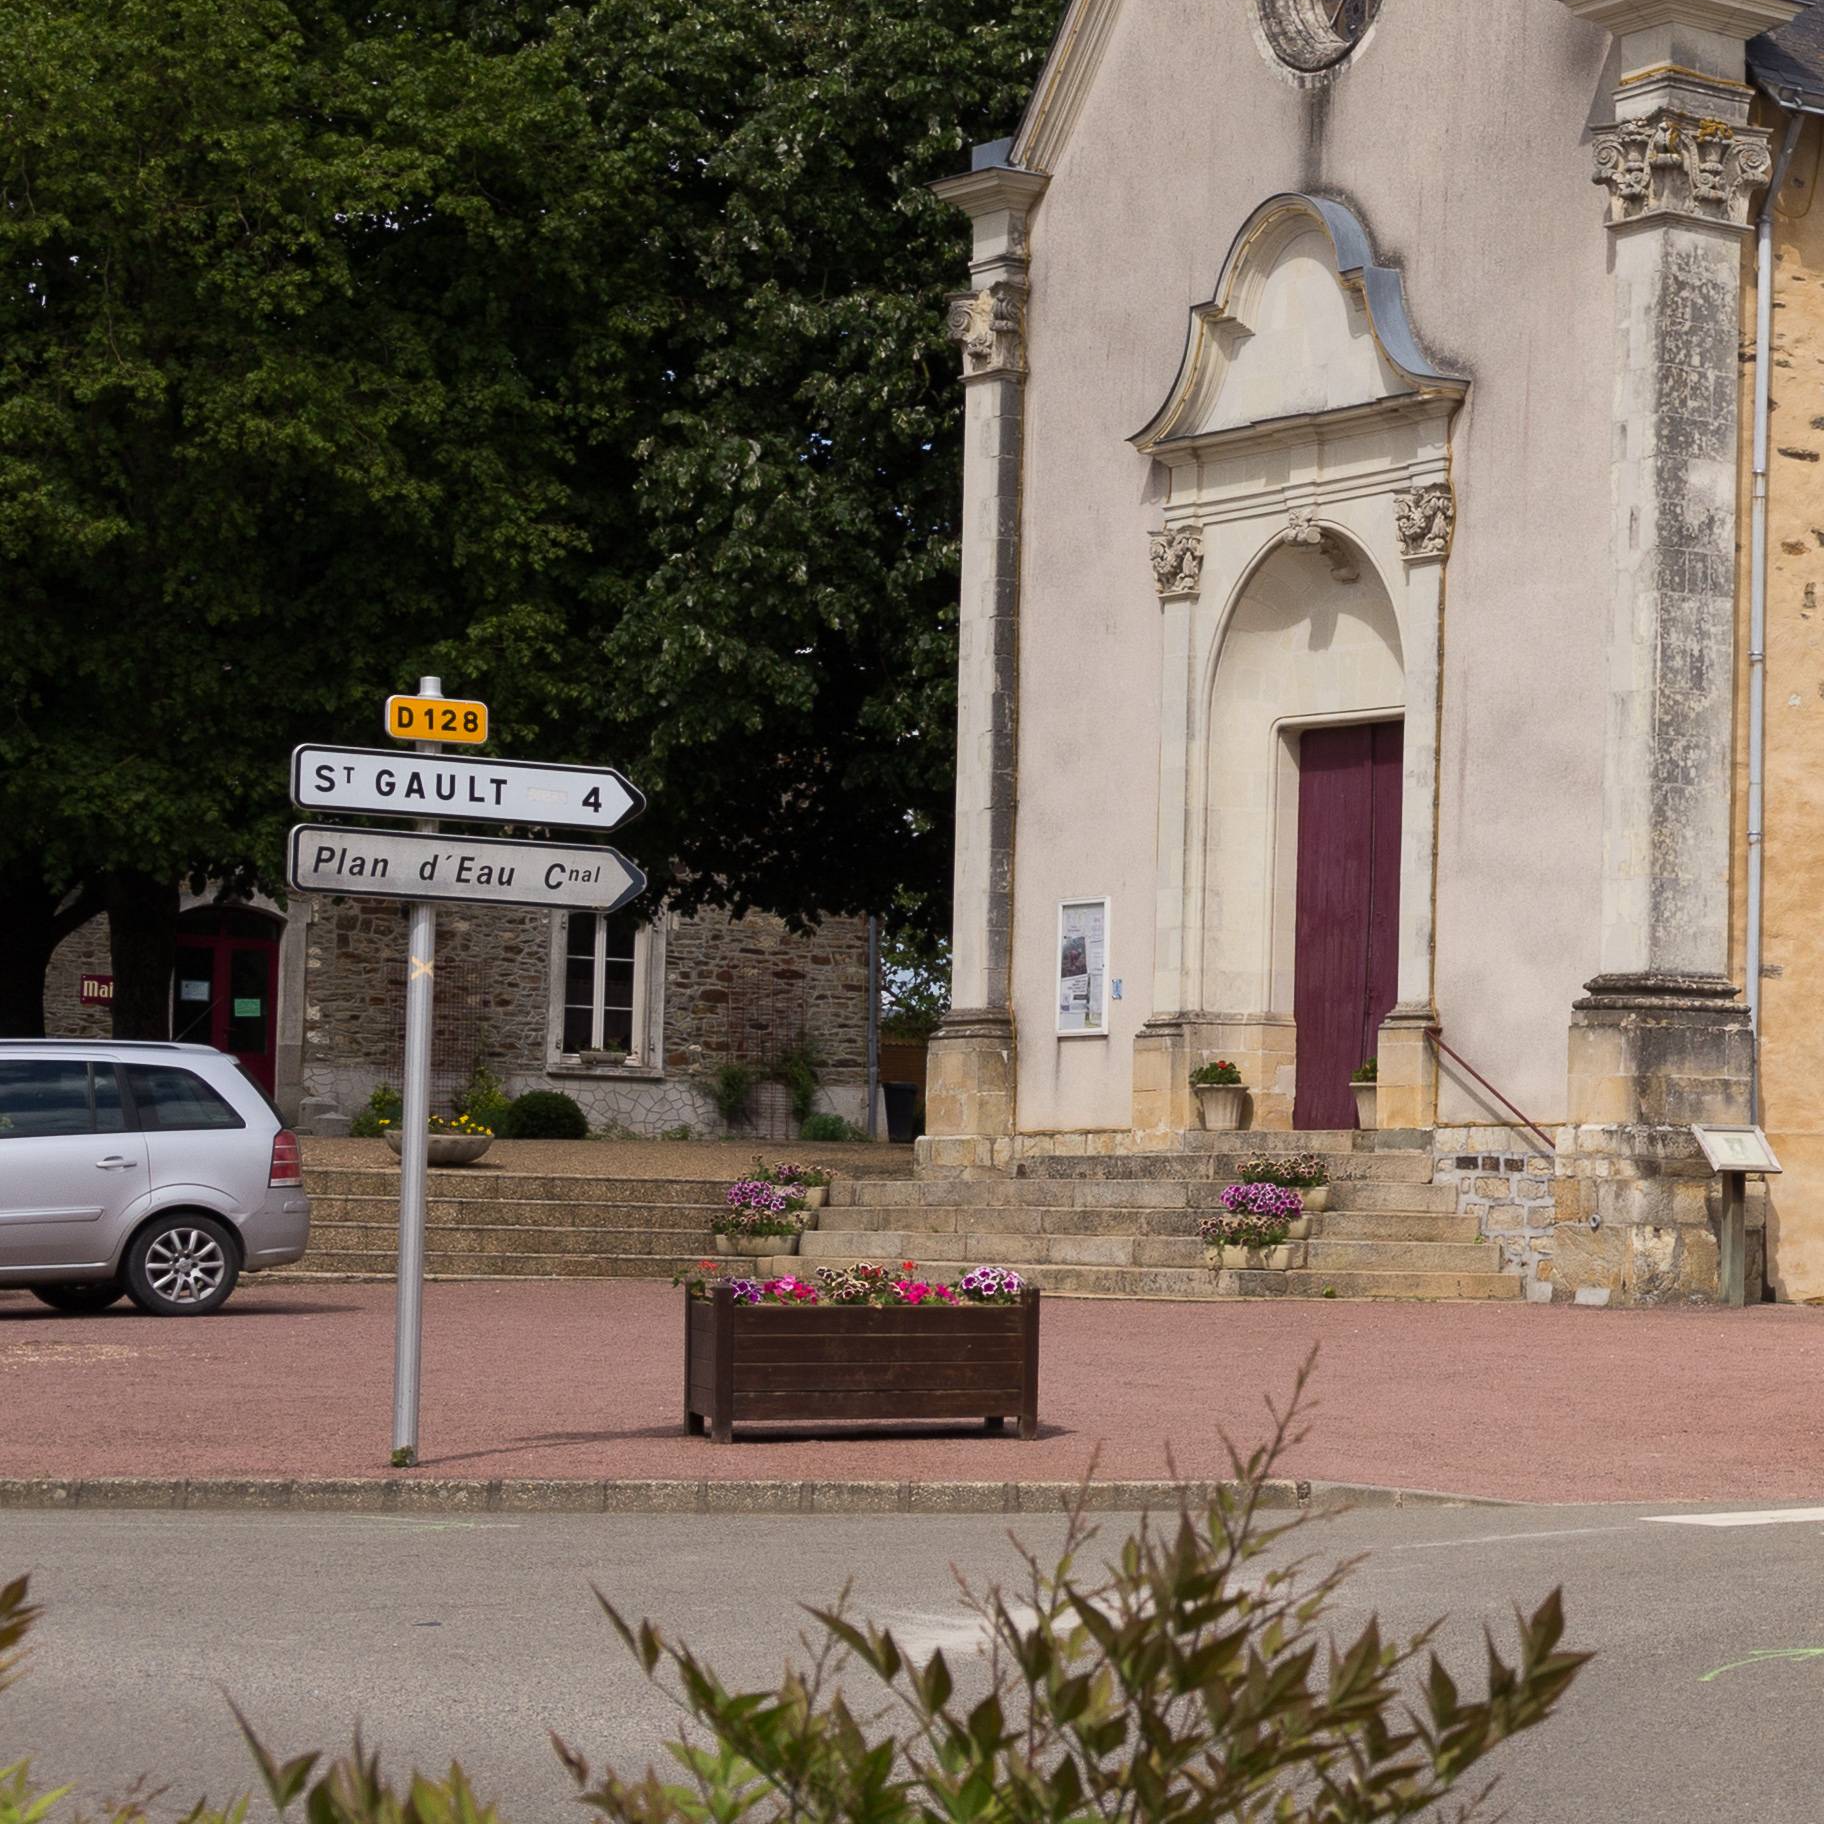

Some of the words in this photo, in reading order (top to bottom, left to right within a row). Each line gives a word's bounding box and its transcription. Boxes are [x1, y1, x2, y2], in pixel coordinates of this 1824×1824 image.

[397, 706, 413, 728] D
[424, 708, 479, 733] 128
[375, 769, 508, 806] GAULT
[581, 786, 602, 813] 4
[313, 846, 389, 878] Plan
[83, 980, 113, 999] Mai
